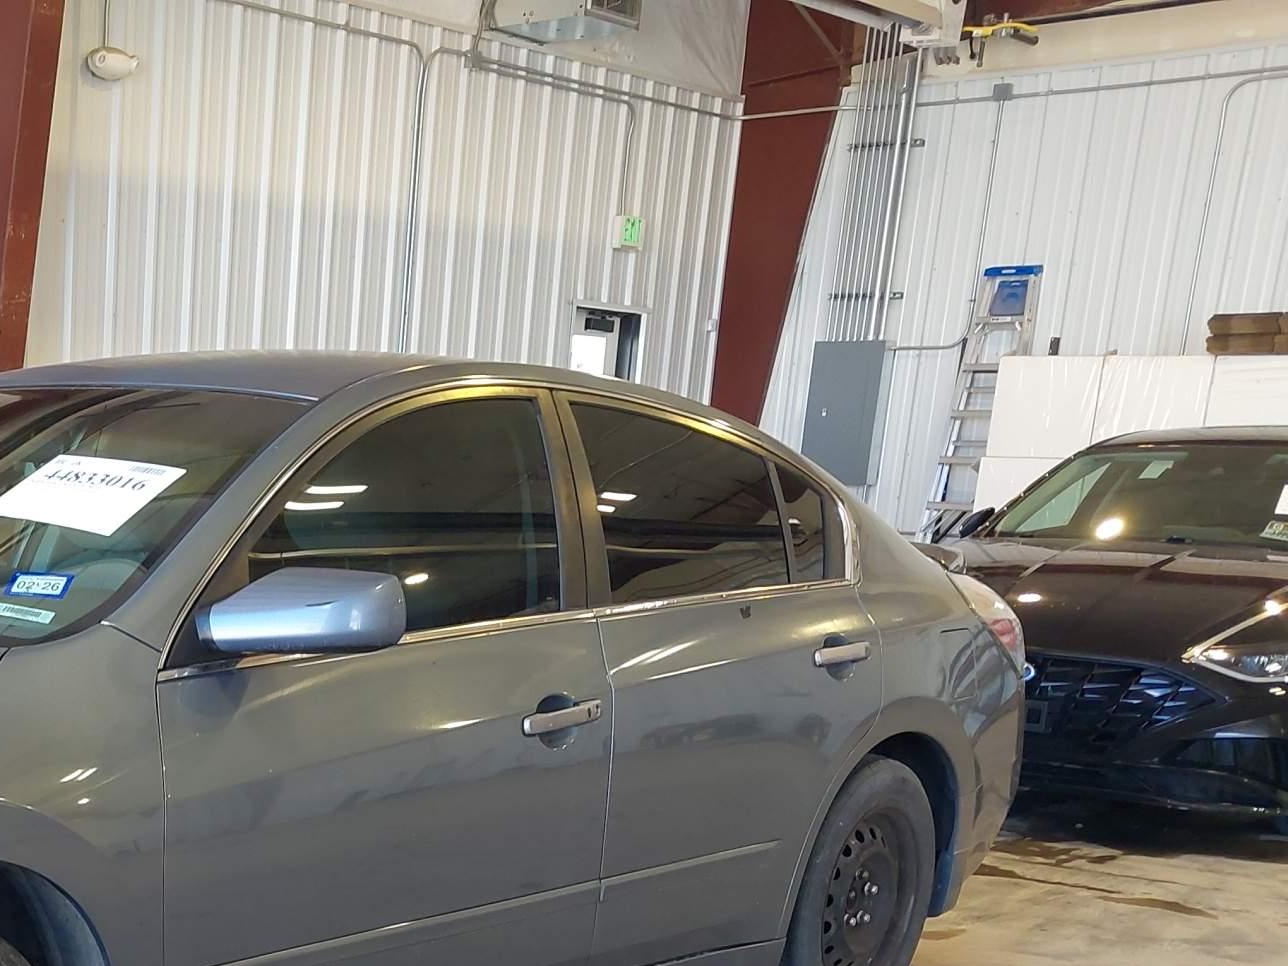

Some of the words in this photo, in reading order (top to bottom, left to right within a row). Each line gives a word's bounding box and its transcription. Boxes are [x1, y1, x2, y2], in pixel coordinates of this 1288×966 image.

[45, 468, 151, 492] 44833016
[16, 580, 35, 592] 02
[41, 581, 61, 592] 26
